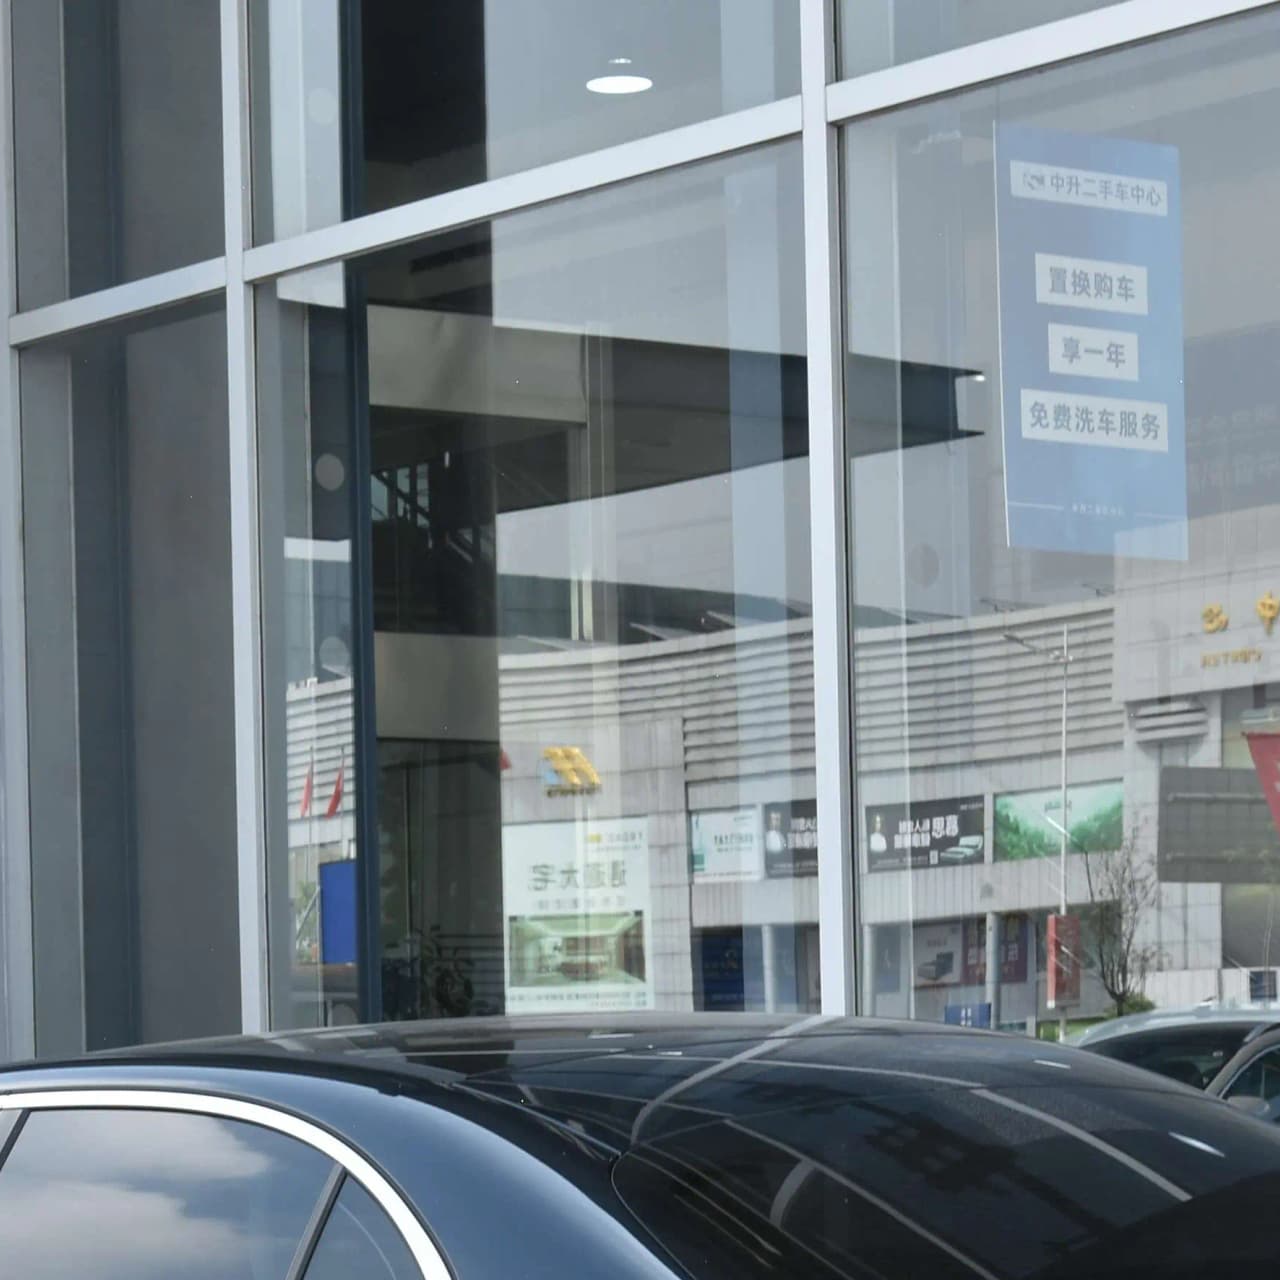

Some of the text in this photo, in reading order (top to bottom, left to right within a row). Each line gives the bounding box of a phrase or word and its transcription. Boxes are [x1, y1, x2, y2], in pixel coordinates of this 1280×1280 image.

[1049, 172, 1162, 208] 中升二手车中心
[1048, 266, 1136, 302] 置换购车
[1061, 336, 1127, 369] 享一年
[1029, 402, 1162, 440] 免费洗车服务
